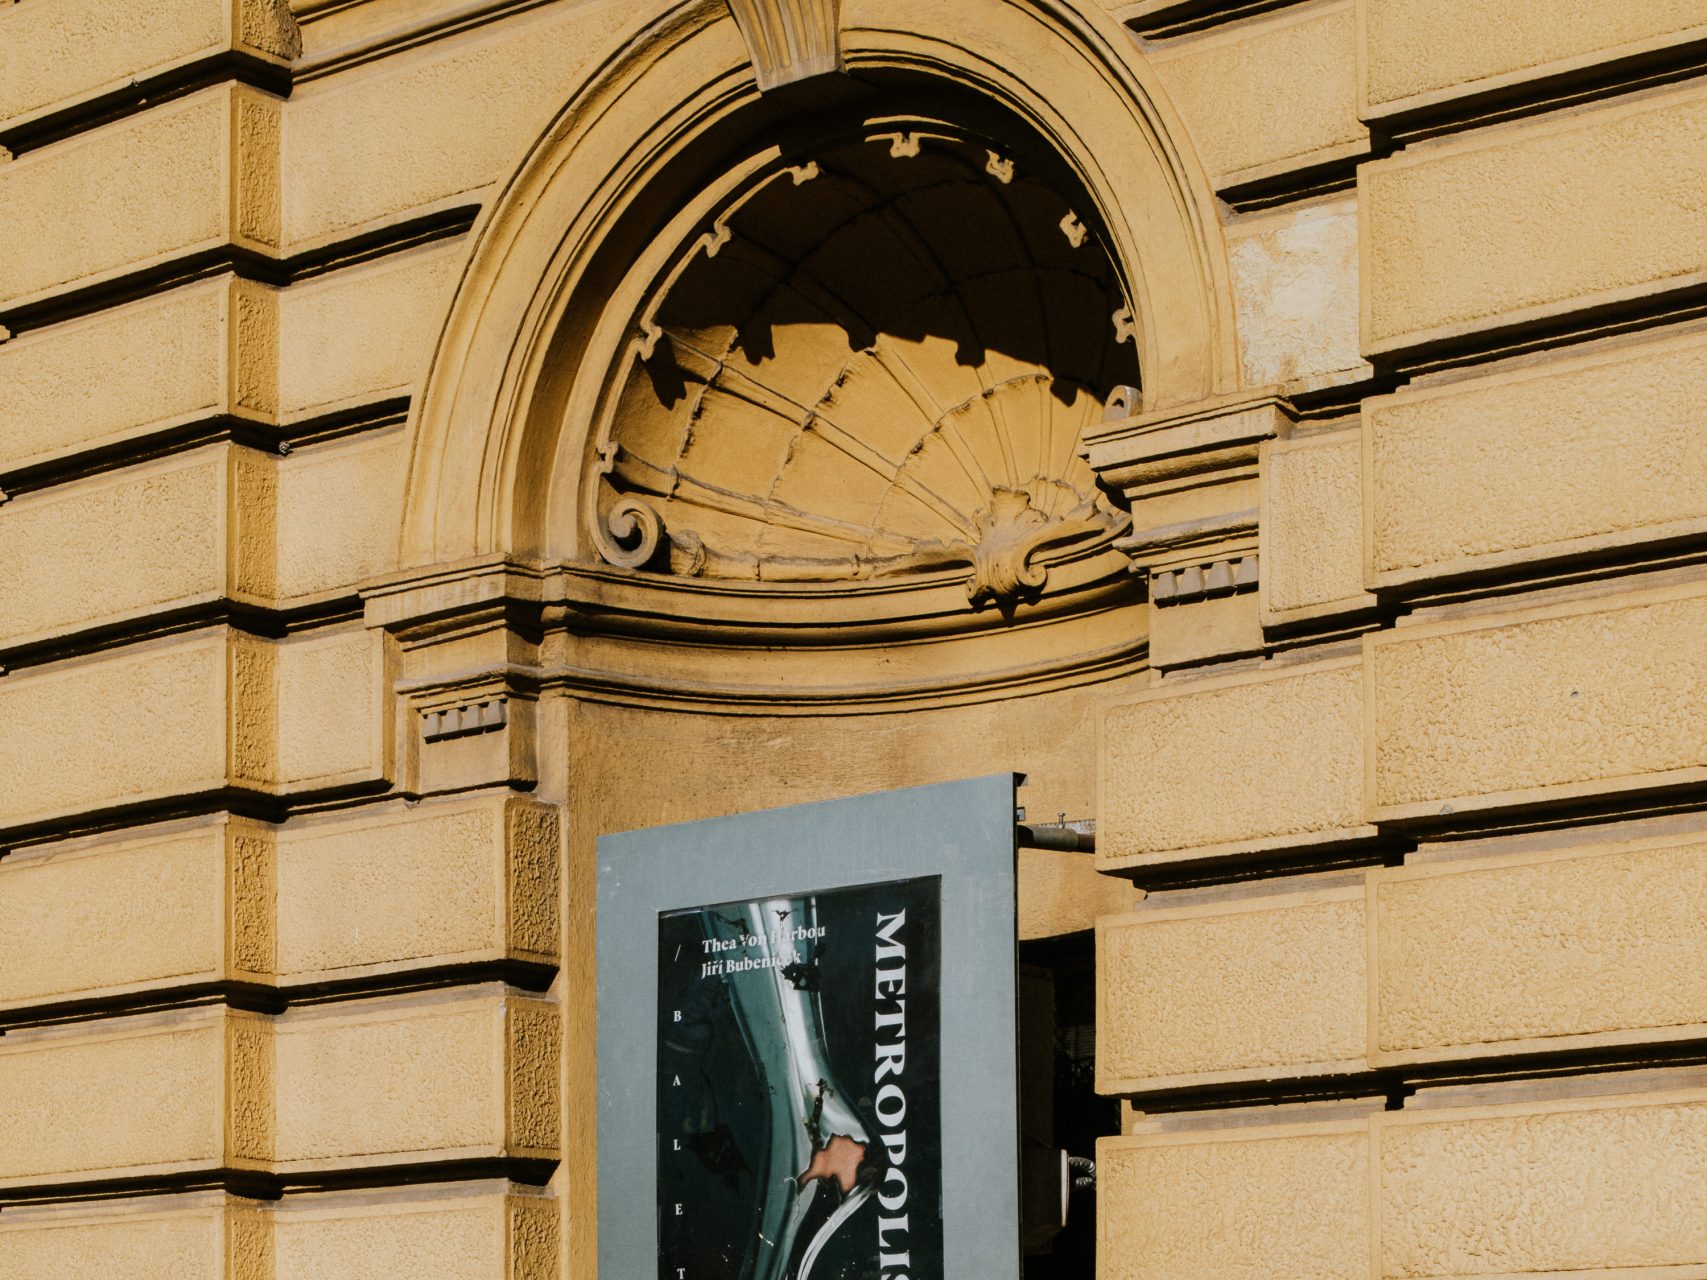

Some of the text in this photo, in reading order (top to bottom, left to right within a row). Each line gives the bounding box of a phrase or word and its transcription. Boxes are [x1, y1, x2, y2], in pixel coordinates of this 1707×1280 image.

[702, 937, 738, 954] Thea
[739, 932, 767, 947] Von
[701, 949, 802, 979] Jiří Bubeník
